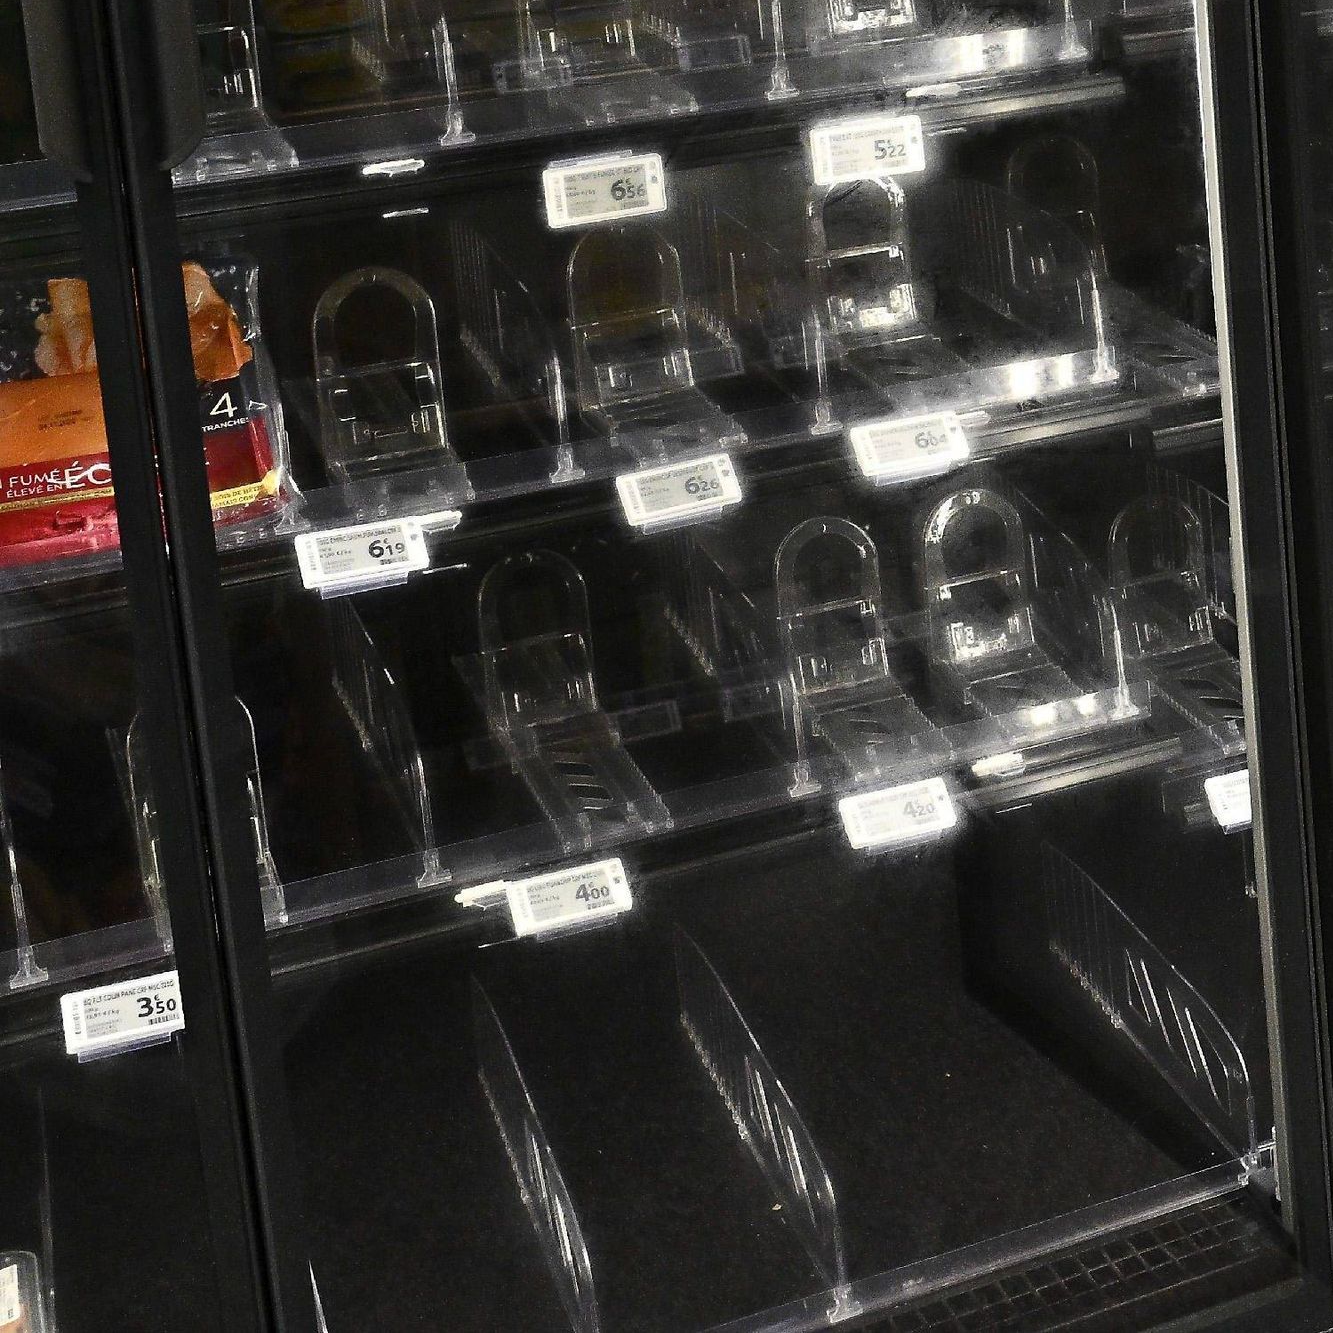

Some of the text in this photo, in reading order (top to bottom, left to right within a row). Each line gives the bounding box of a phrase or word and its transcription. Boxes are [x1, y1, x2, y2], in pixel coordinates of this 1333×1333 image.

[209, 391, 238, 418] 4
[9, 468, 60, 489] FUMÉ
[6, 482, 63, 499] ÉLEVÉ EN
[137, 994, 176, 1018] 3€50
